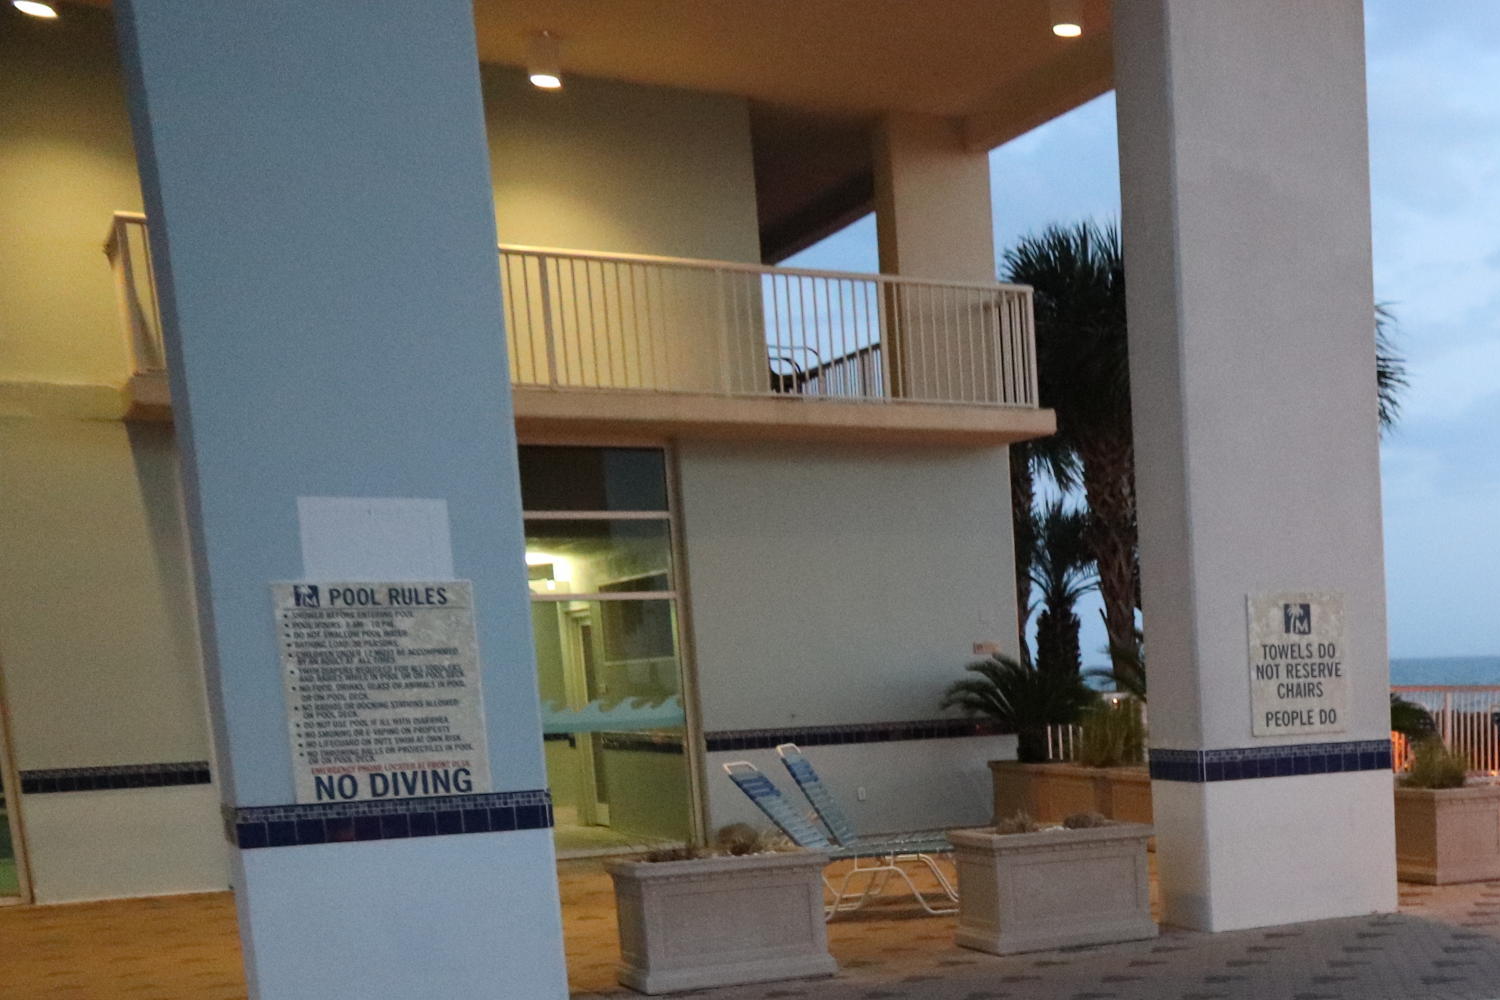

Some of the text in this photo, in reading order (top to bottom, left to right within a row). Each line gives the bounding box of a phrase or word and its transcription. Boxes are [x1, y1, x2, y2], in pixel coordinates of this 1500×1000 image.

[329, 587, 448, 606] POOL RULES
[1262, 643, 1336, 660] TOWELS DO
[1256, 662, 1342, 680] NOT RESERVE
[1277, 682, 1323, 699] CHAIRS
[1265, 709, 1337, 727] PEOPLE DO
[314, 768, 473, 800] NO DIVING
